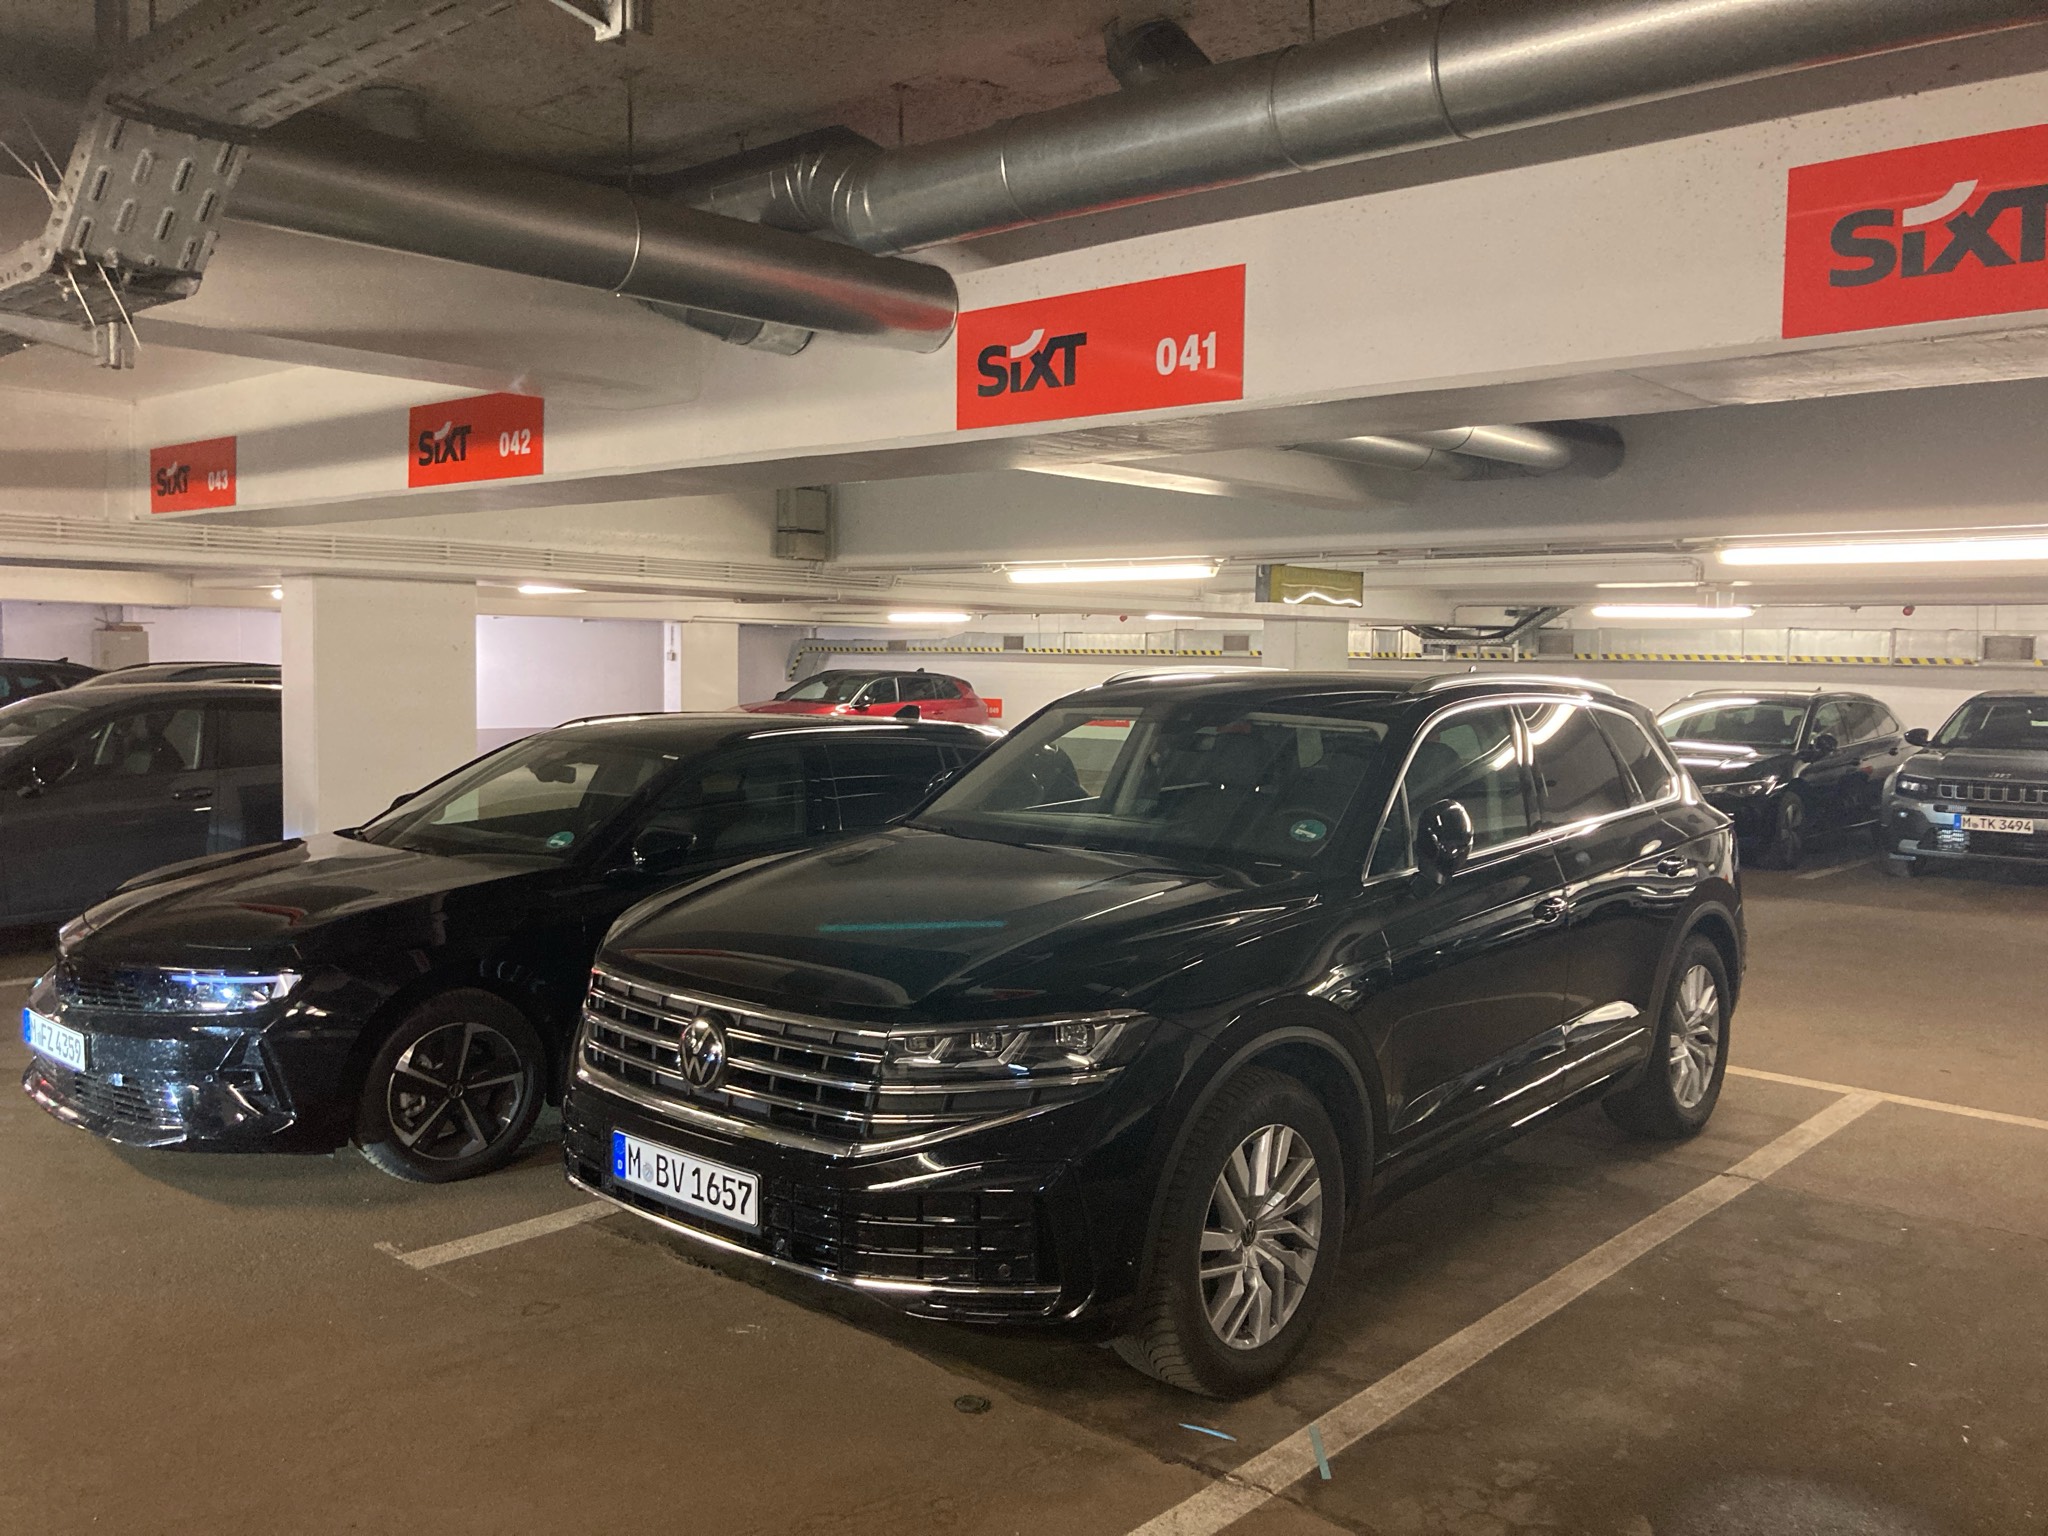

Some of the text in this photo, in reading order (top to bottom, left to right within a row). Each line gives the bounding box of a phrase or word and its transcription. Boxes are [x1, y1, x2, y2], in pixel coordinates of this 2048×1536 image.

[1155, 331, 1216, 376] 041
[499, 428, 531, 457] 042
[208, 469, 229, 492] 043
[1962, 817, 2032, 832] M TK 3494
[41, 1023, 54, 1052] FZ
[55, 1030, 81, 1064] 4359
[628, 1143, 641, 1179] M
[656, 1153, 685, 1194] BV
[691, 1167, 753, 1215] 1657
